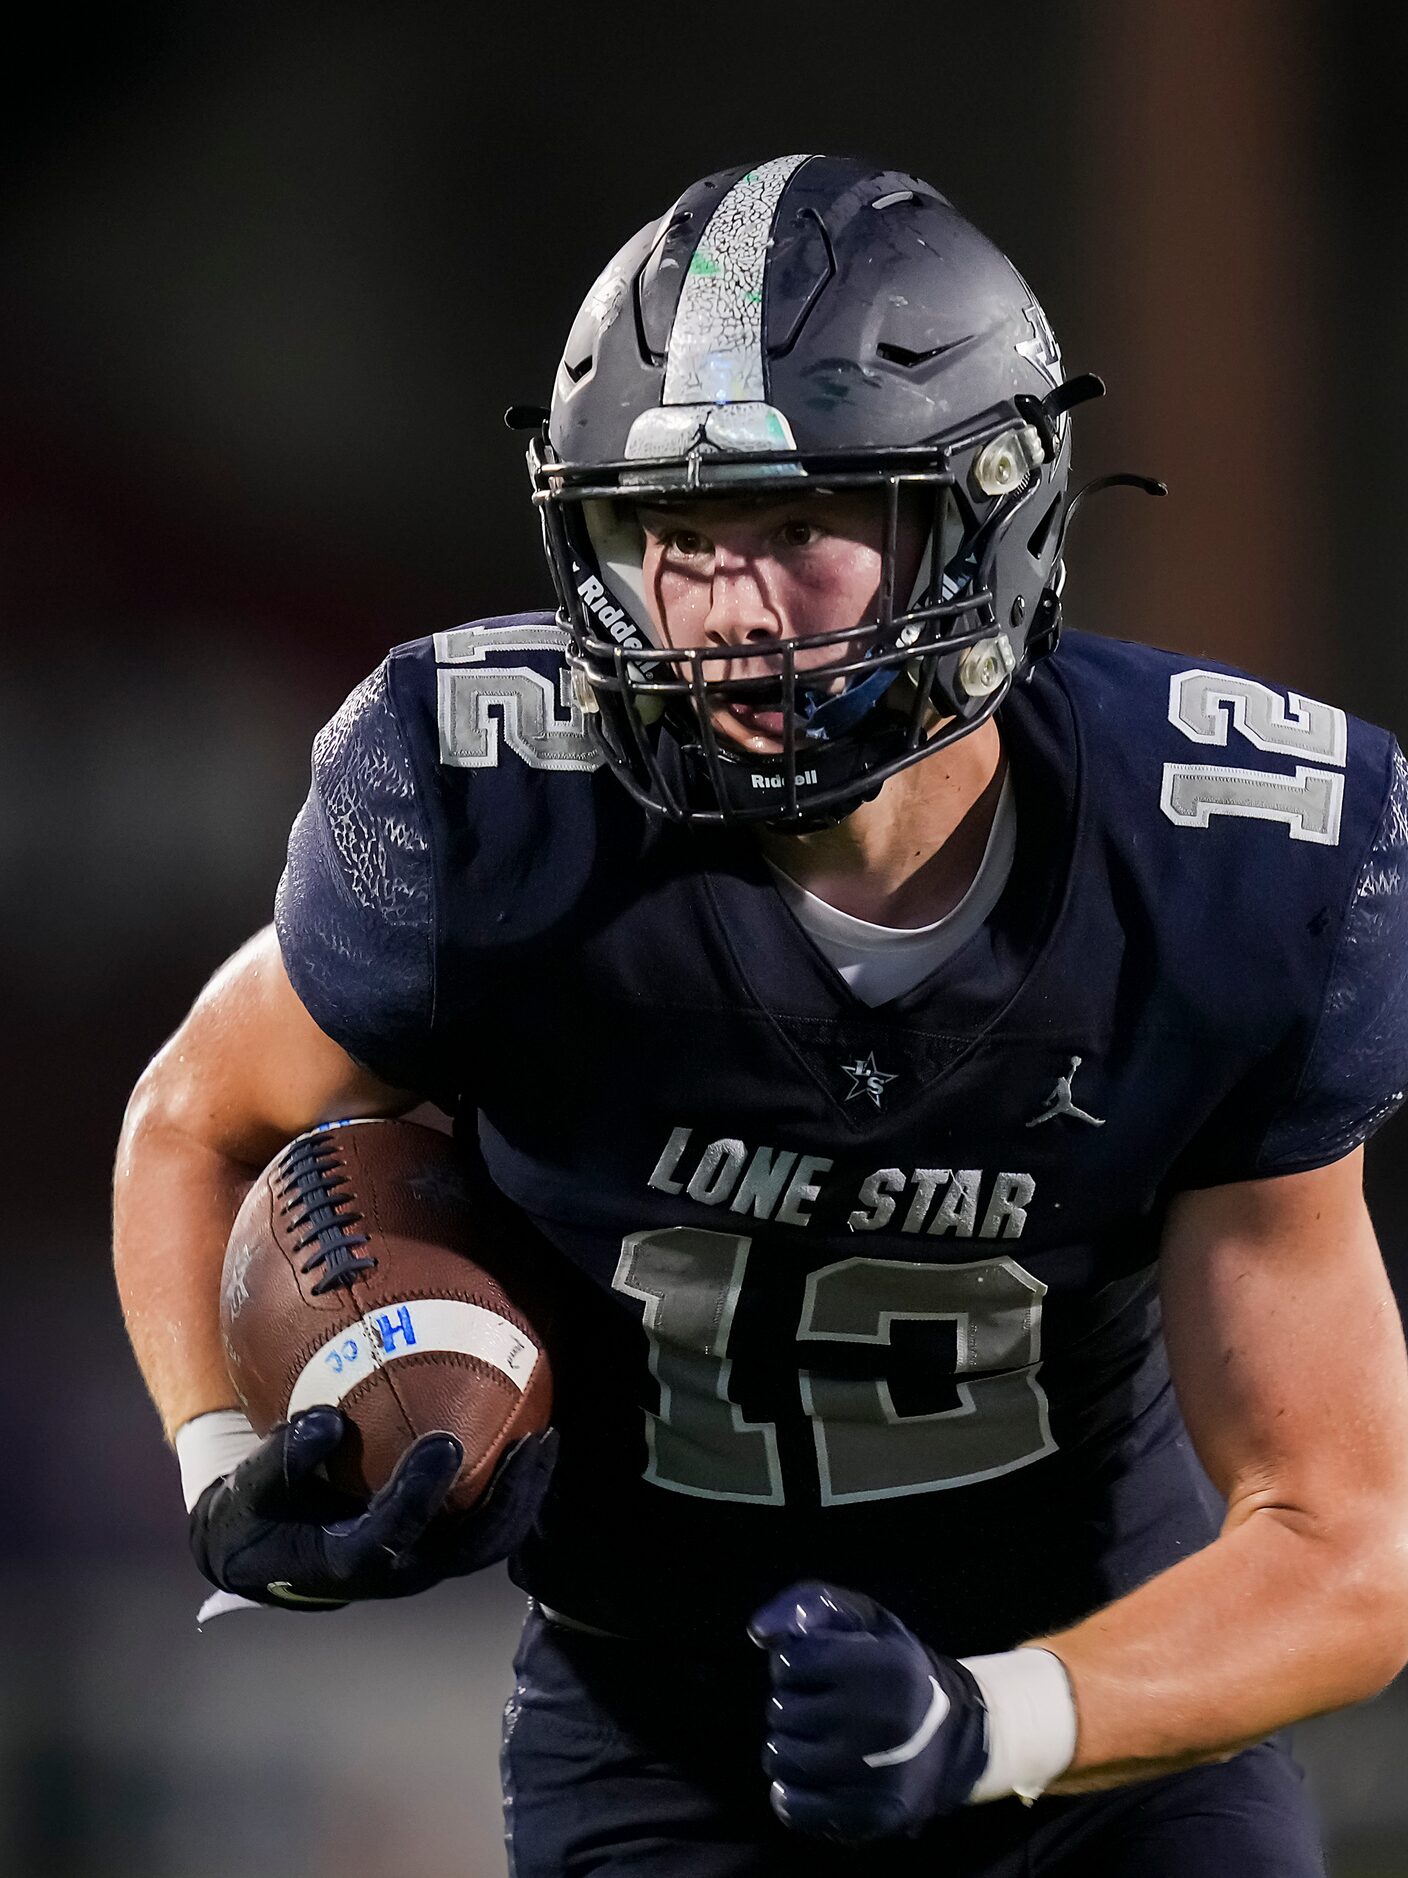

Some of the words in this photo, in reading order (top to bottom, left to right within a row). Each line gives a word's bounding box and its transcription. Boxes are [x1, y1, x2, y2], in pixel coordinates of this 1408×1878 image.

[434, 621, 602, 774] 12
[1160, 668, 1348, 847] 12
[751, 769, 818, 788] Ridell
[647, 1127, 834, 1227] LONE
[847, 1167, 1036, 1239] STAR
[611, 1226, 1061, 1508] 12
